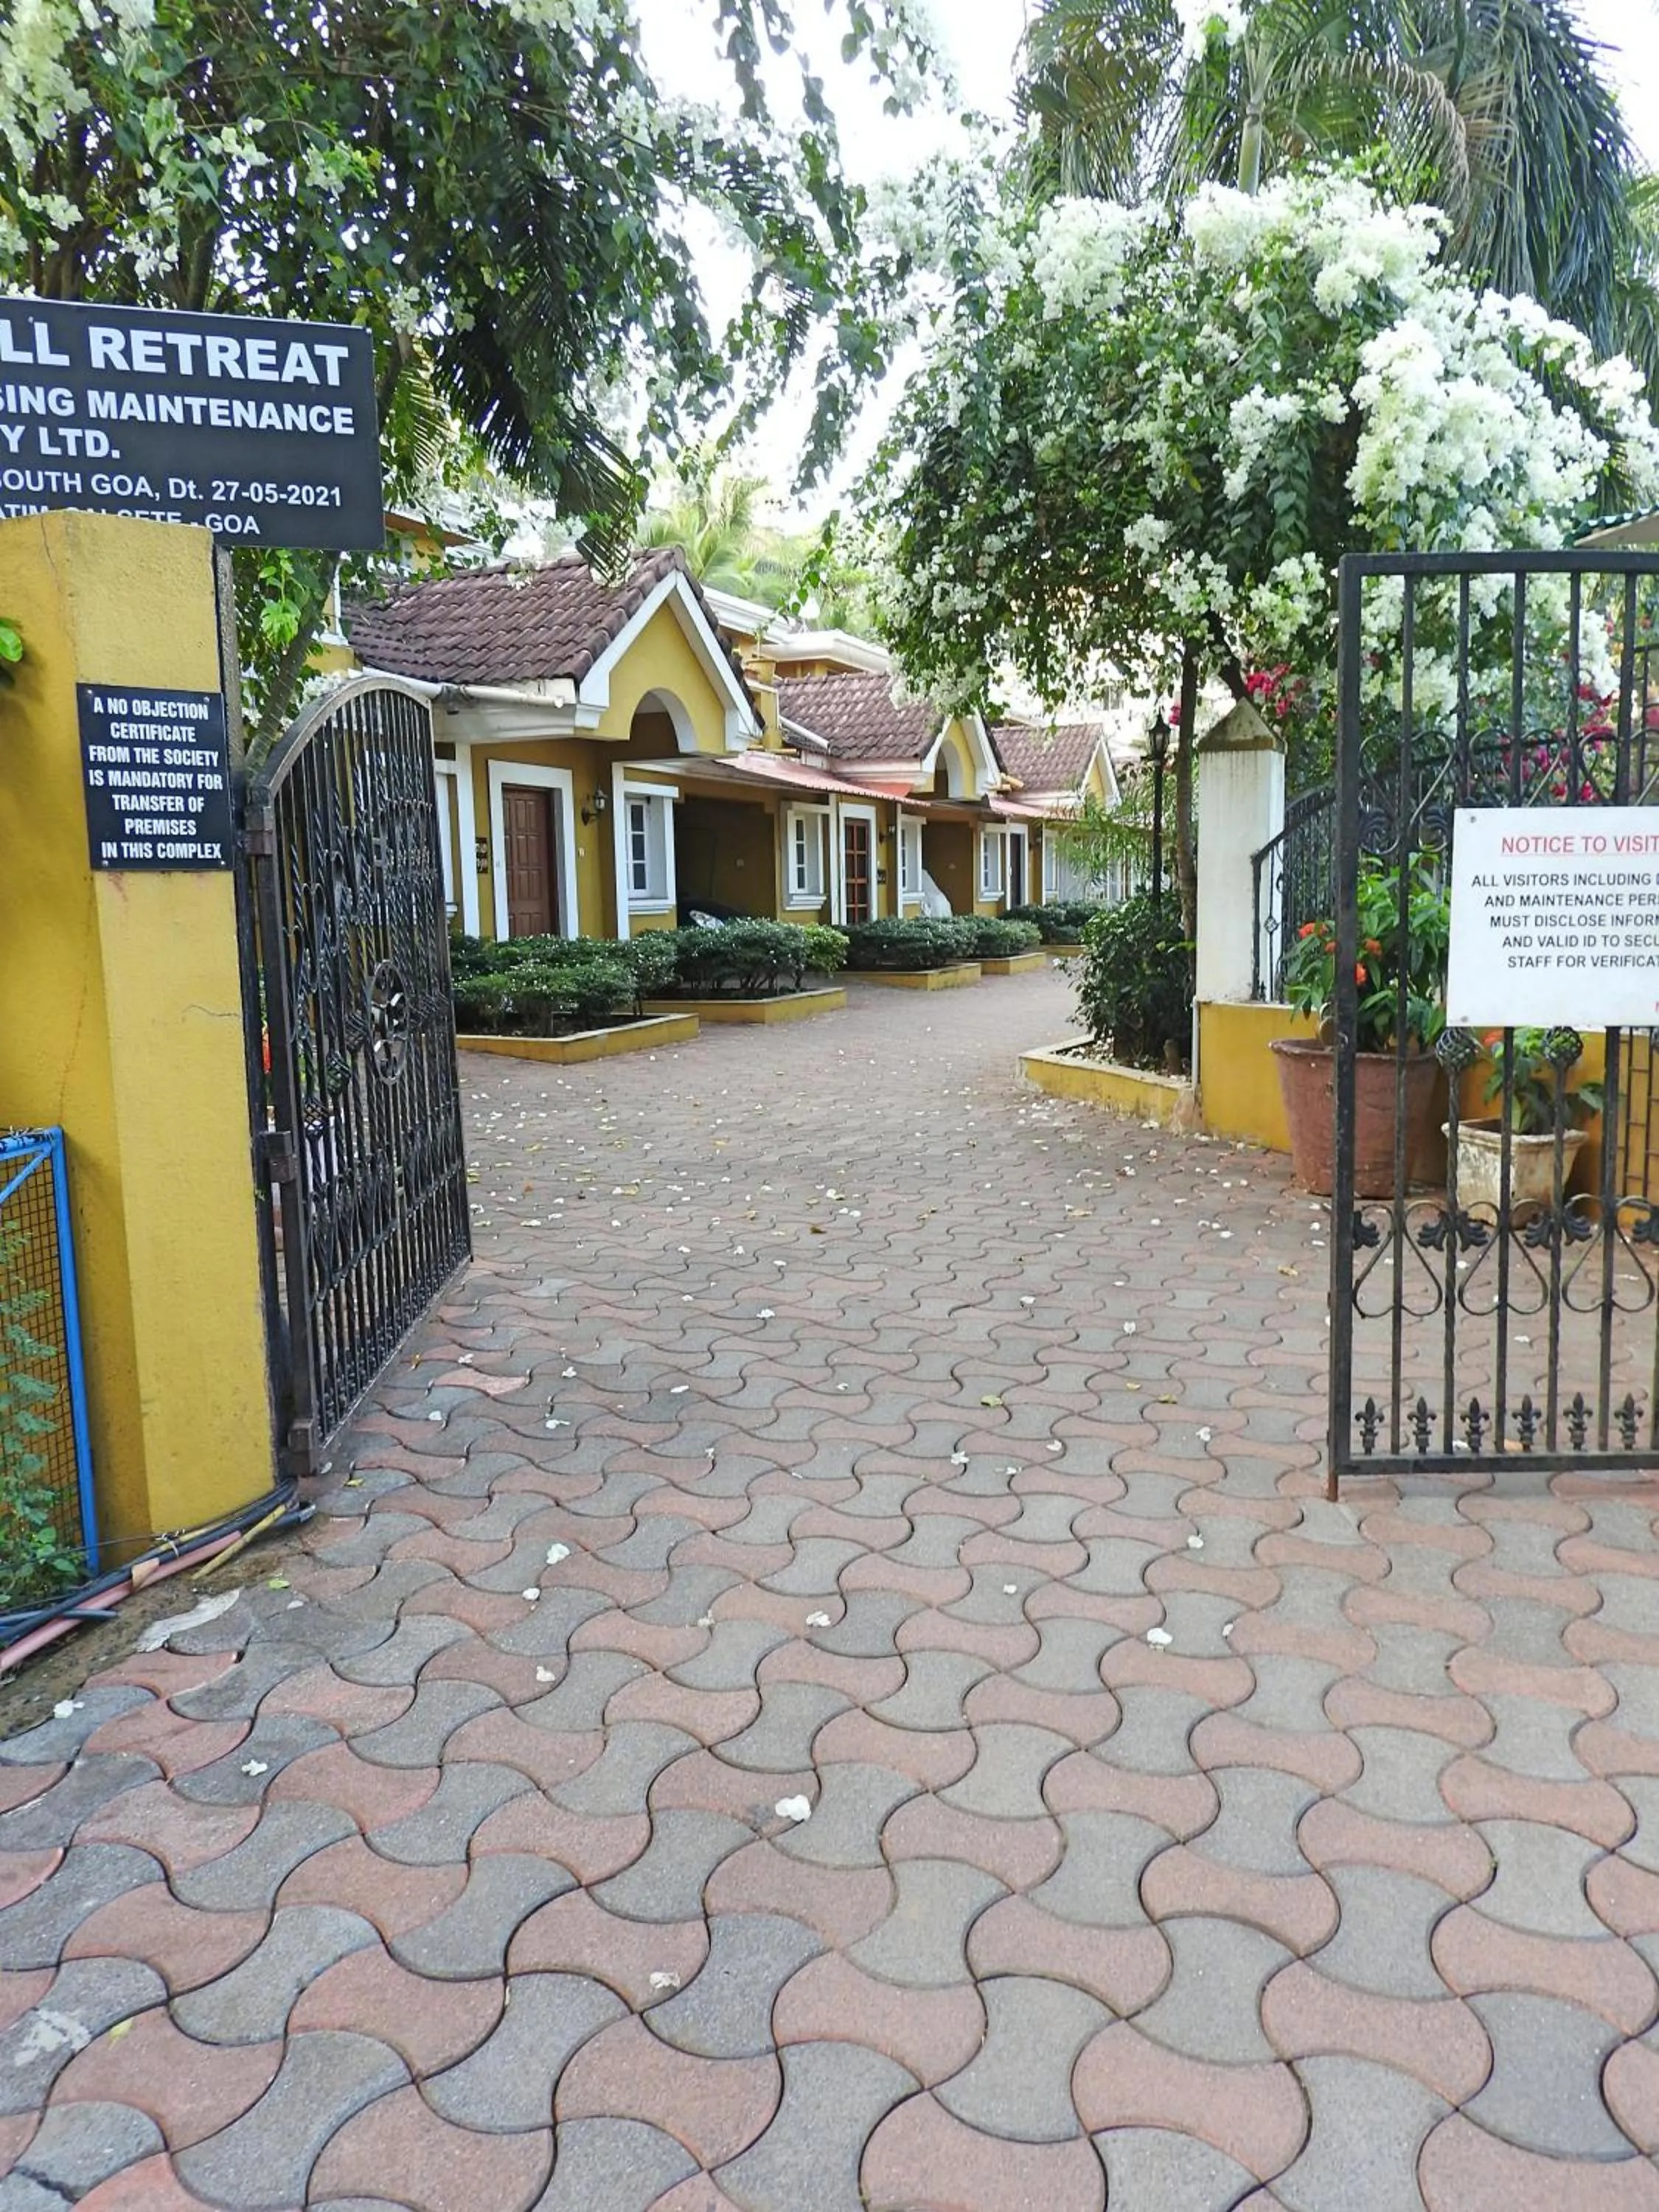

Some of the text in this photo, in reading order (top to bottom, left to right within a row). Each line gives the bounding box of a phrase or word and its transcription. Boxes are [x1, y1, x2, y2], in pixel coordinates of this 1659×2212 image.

[0, 319, 349, 386] LL RETREAT
[0, 384, 355, 435] ING MAINTENANCE
[0, 424, 120, 459] Y LTD.
[0, 468, 342, 507] OUTH GOA, Dt. 27-05-2021
[206, 513, 260, 535] GOA
[94, 697, 209, 720] A NO OBJECTION
[111, 722, 196, 742] CERTIFICATE
[88, 745, 219, 767] FROM THE SOCIETY
[88, 770, 223, 790] IS MANDATORY FOR
[112, 794, 204, 813] TRANSFER OF
[125, 818, 197, 835] PREMISES
[101, 842, 221, 859] IN THIS COMPLEX
[1501, 836, 1574, 853] NOTICE
[1581, 835, 1607, 852] TO
[1472, 874, 1498, 887] ALL
[1503, 873, 1568, 886] VISITORS
[1573, 872, 1651, 886] INCLUDING
[1484, 894, 1659, 908] AND MAINTENANCE PER
[1490, 915, 1530, 928] MUST
[1535, 914, 1607, 928] DISCLOSE
[1502, 935, 1533, 948] AND
[1537, 935, 1579, 948] VALID
[1584, 935, 1596, 947] ID
[1601, 934, 1620, 947] TO
[1507, 956, 1551, 968] STAFF
[1557, 956, 1586, 968] FOR
